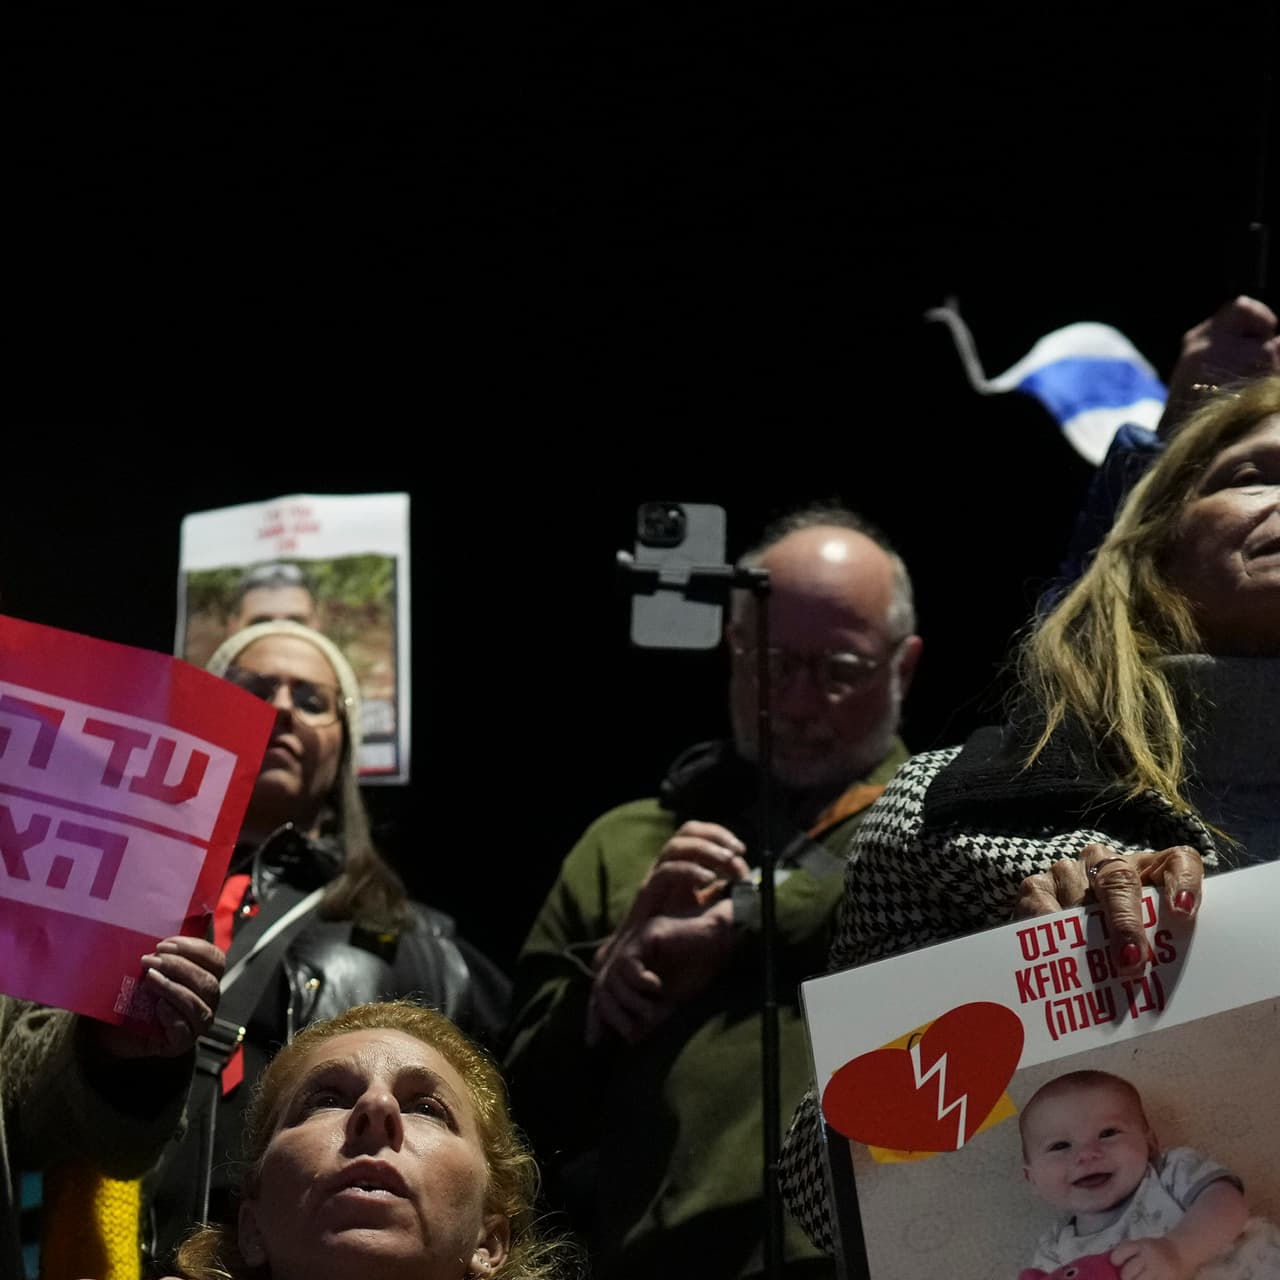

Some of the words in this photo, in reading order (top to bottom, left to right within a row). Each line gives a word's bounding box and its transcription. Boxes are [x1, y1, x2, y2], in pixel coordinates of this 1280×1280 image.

[82, 717, 210, 804] עד
[1015, 956, 1082, 1004] KFIR
[1086, 930, 1177, 984] BIS
[1016, 916, 1088, 962] ביבס
